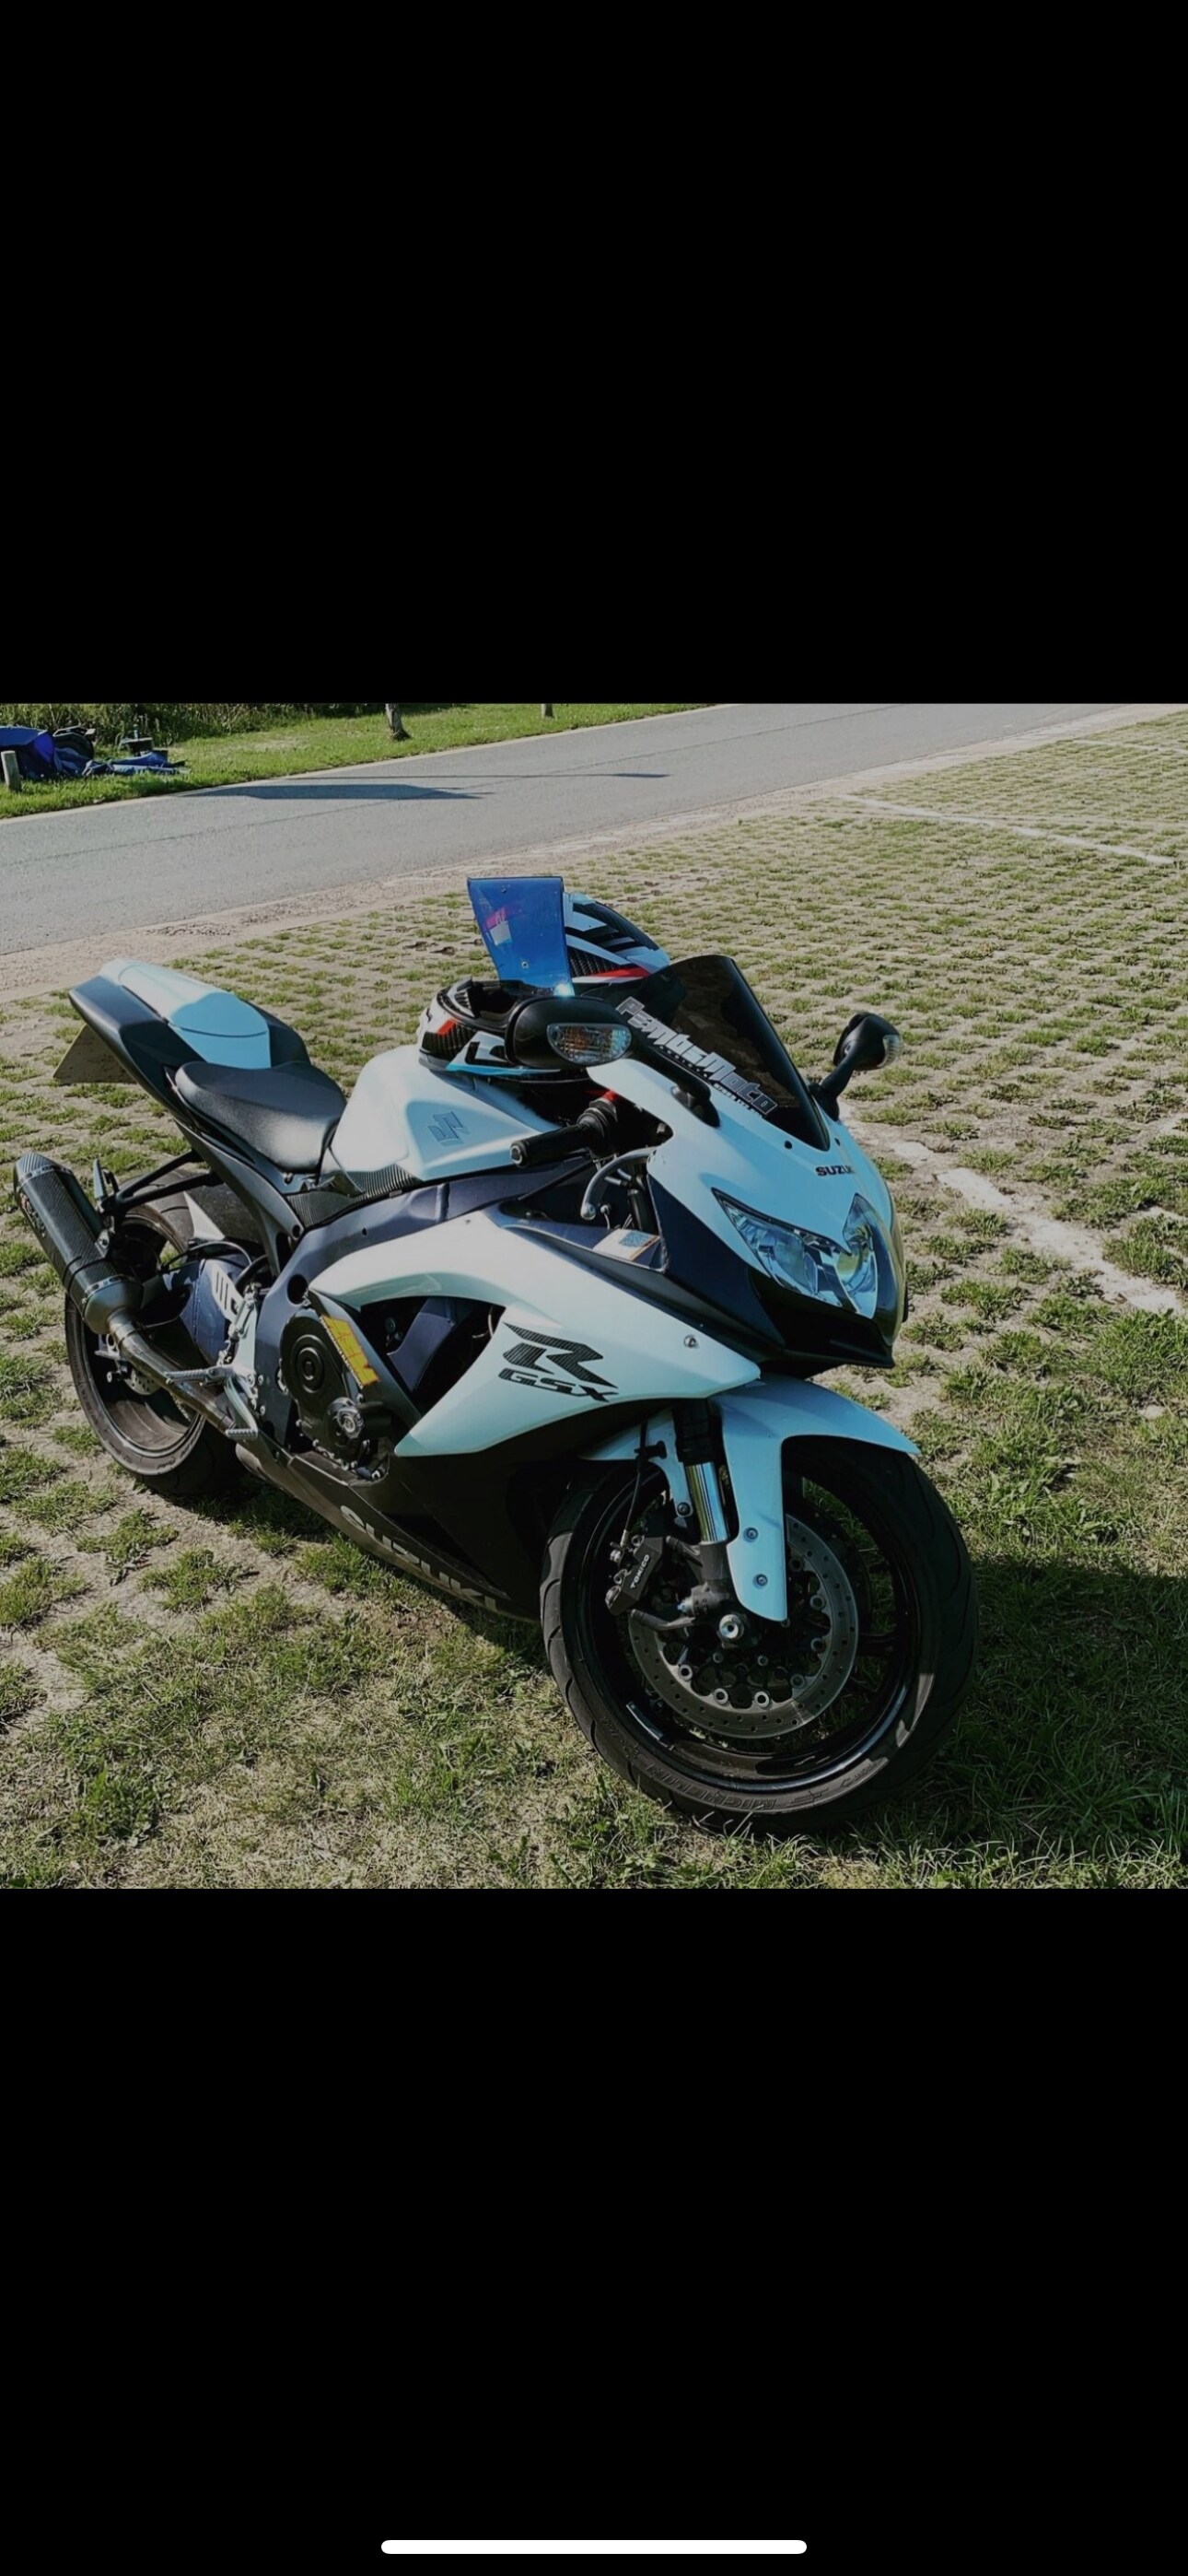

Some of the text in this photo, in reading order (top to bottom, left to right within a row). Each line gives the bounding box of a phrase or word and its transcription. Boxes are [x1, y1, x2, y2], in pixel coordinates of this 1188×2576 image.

[815, 1165, 856, 1177] SUZUK
[502, 1321, 619, 1389] R
[498, 1367, 619, 1402] GSX
[630, 1554, 650, 1588] TOKICO
